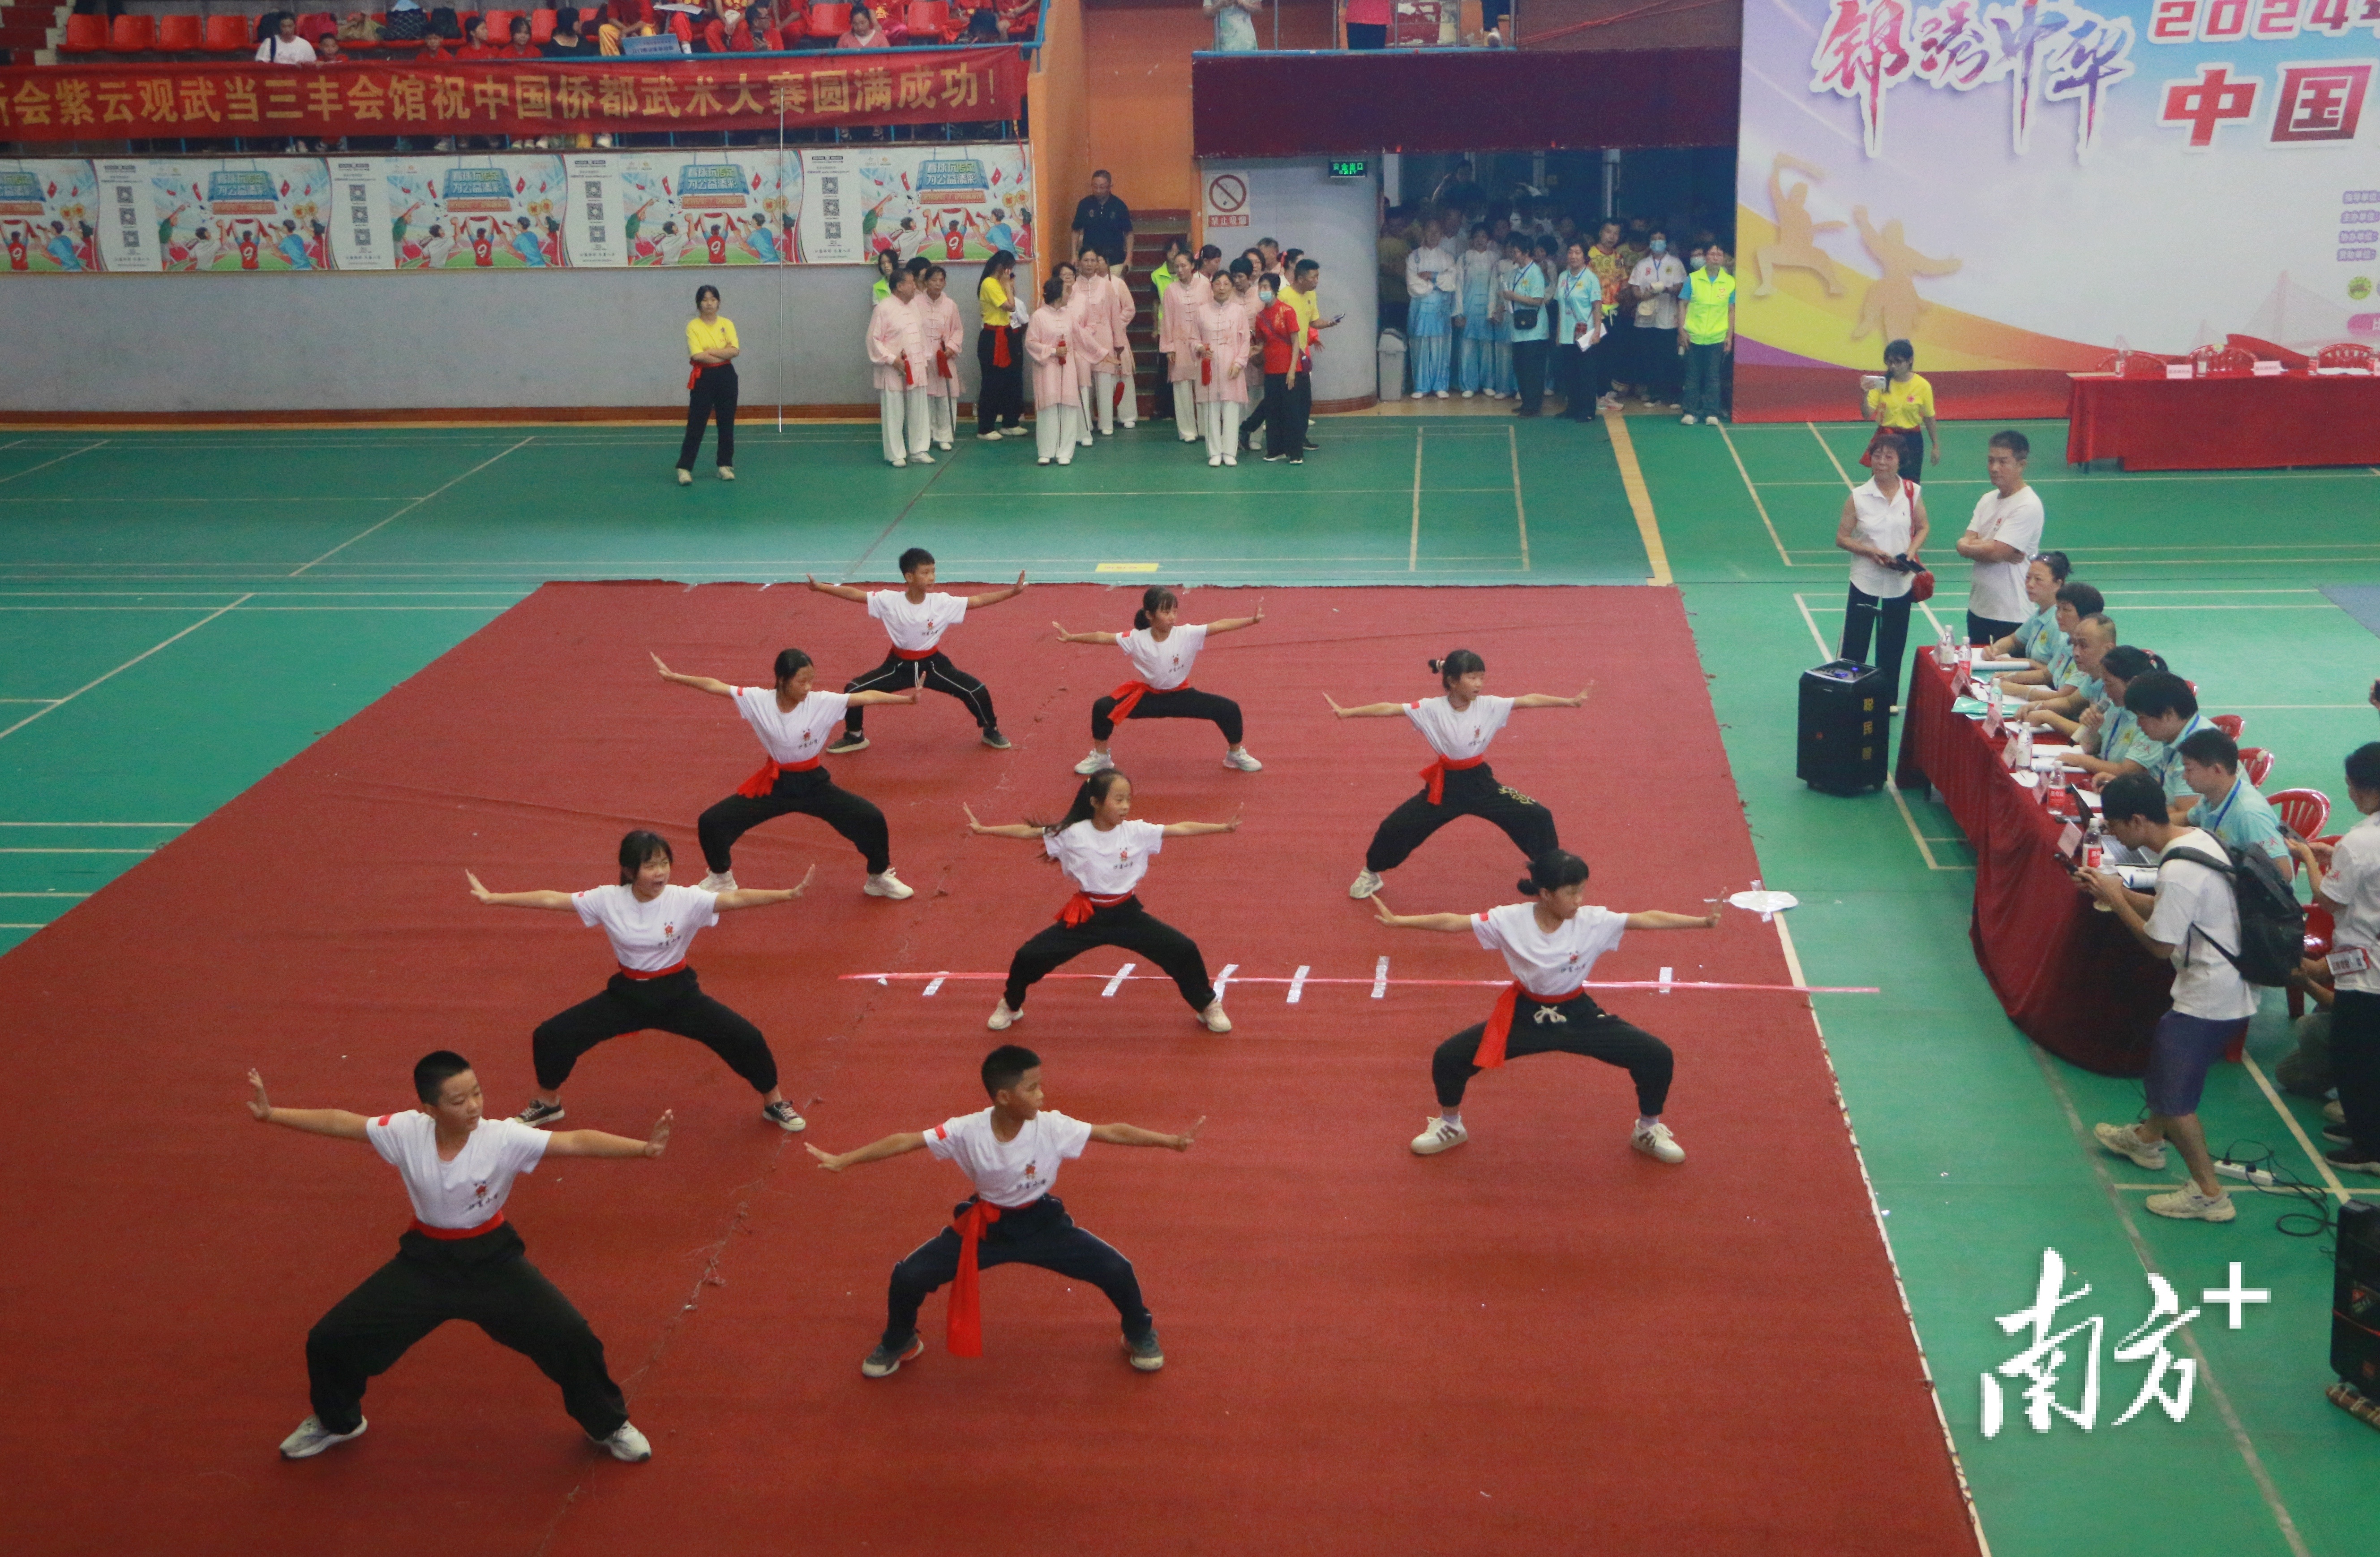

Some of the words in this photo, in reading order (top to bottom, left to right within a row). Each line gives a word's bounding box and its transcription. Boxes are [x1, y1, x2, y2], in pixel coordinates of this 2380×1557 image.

[2154, 0, 2380, 37] 2024
[2162, 65, 2372, 146] 中国
[1211, 215, 1247, 225] 禁止吸烟
